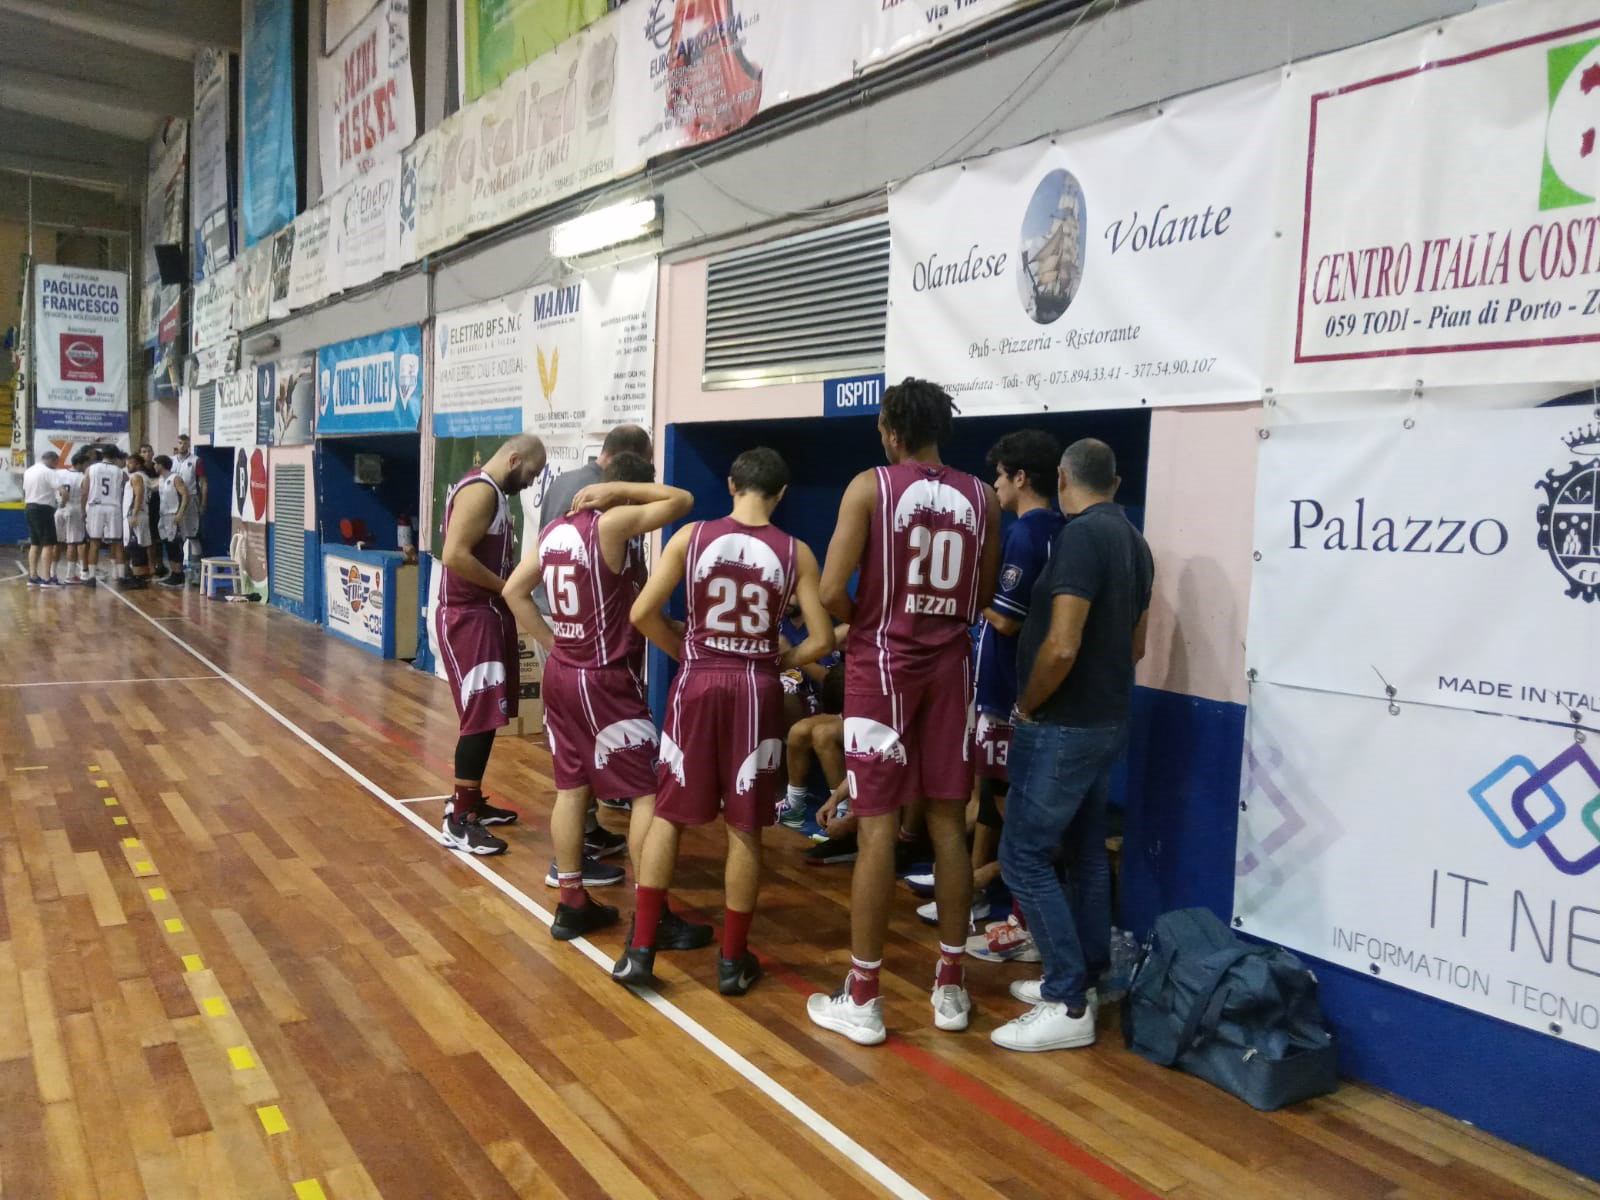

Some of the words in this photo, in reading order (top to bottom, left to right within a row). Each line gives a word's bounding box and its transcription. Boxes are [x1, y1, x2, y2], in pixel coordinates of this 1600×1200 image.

[926, 5, 949, 23] Via
[1105, 203, 1233, 256] Volante
[912, 244, 1008, 293] Olandese
[1312, 242, 1412, 305] CENTRO
[1414, 229, 1513, 293] ITALIA
[1518, 214, 1600, 283] COST
[42, 295, 119, 316] FRANCESCO
[43, 279, 119, 300] PAGLIACCIA
[534, 283, 581, 322] MANNI
[1325, 314, 1357, 338] 059
[1362, 307, 1410, 336] TODI
[1427, 303, 1472, 330] Pian
[1478, 299, 1499, 325] di
[1504, 297, 1562, 324] Porto
[1582, 288, 1600, 316] Z
[450, 322, 484, 345] ELETTRO
[968, 337, 990, 360] Pub
[998, 336, 1052, 356] Pizzeria
[1065, 324, 1141, 350] Ristorante
[363, 361, 393, 405] VOLLEY
[1001, 373, 1019, 390] Todi
[1027, 373, 1041, 391] PG
[1049, 367, 1121, 387] 075.894.33.41
[1132, 357, 1217, 379] 377.54.90.107
[836, 379, 880, 408] OSPITI
[102, 477, 110, 496] 5
[1288, 497, 1509, 556] Palazzo
[907, 525, 964, 590] 20
[543, 565, 579, 616] 15
[706, 577, 770, 634] 23
[904, 593, 957, 616] AEZZO
[705, 636, 770, 654] AREZZO
[1438, 675, 1513, 699] MADE
[1521, 684, 1546, 705] IN
[983, 740, 1009, 766] 13
[1430, 869, 1489, 938] IT
[1510, 889, 1600, 978] NE
[1332, 927, 1491, 997] INFORMATION
[1506, 980, 1600, 1031] TECNO
